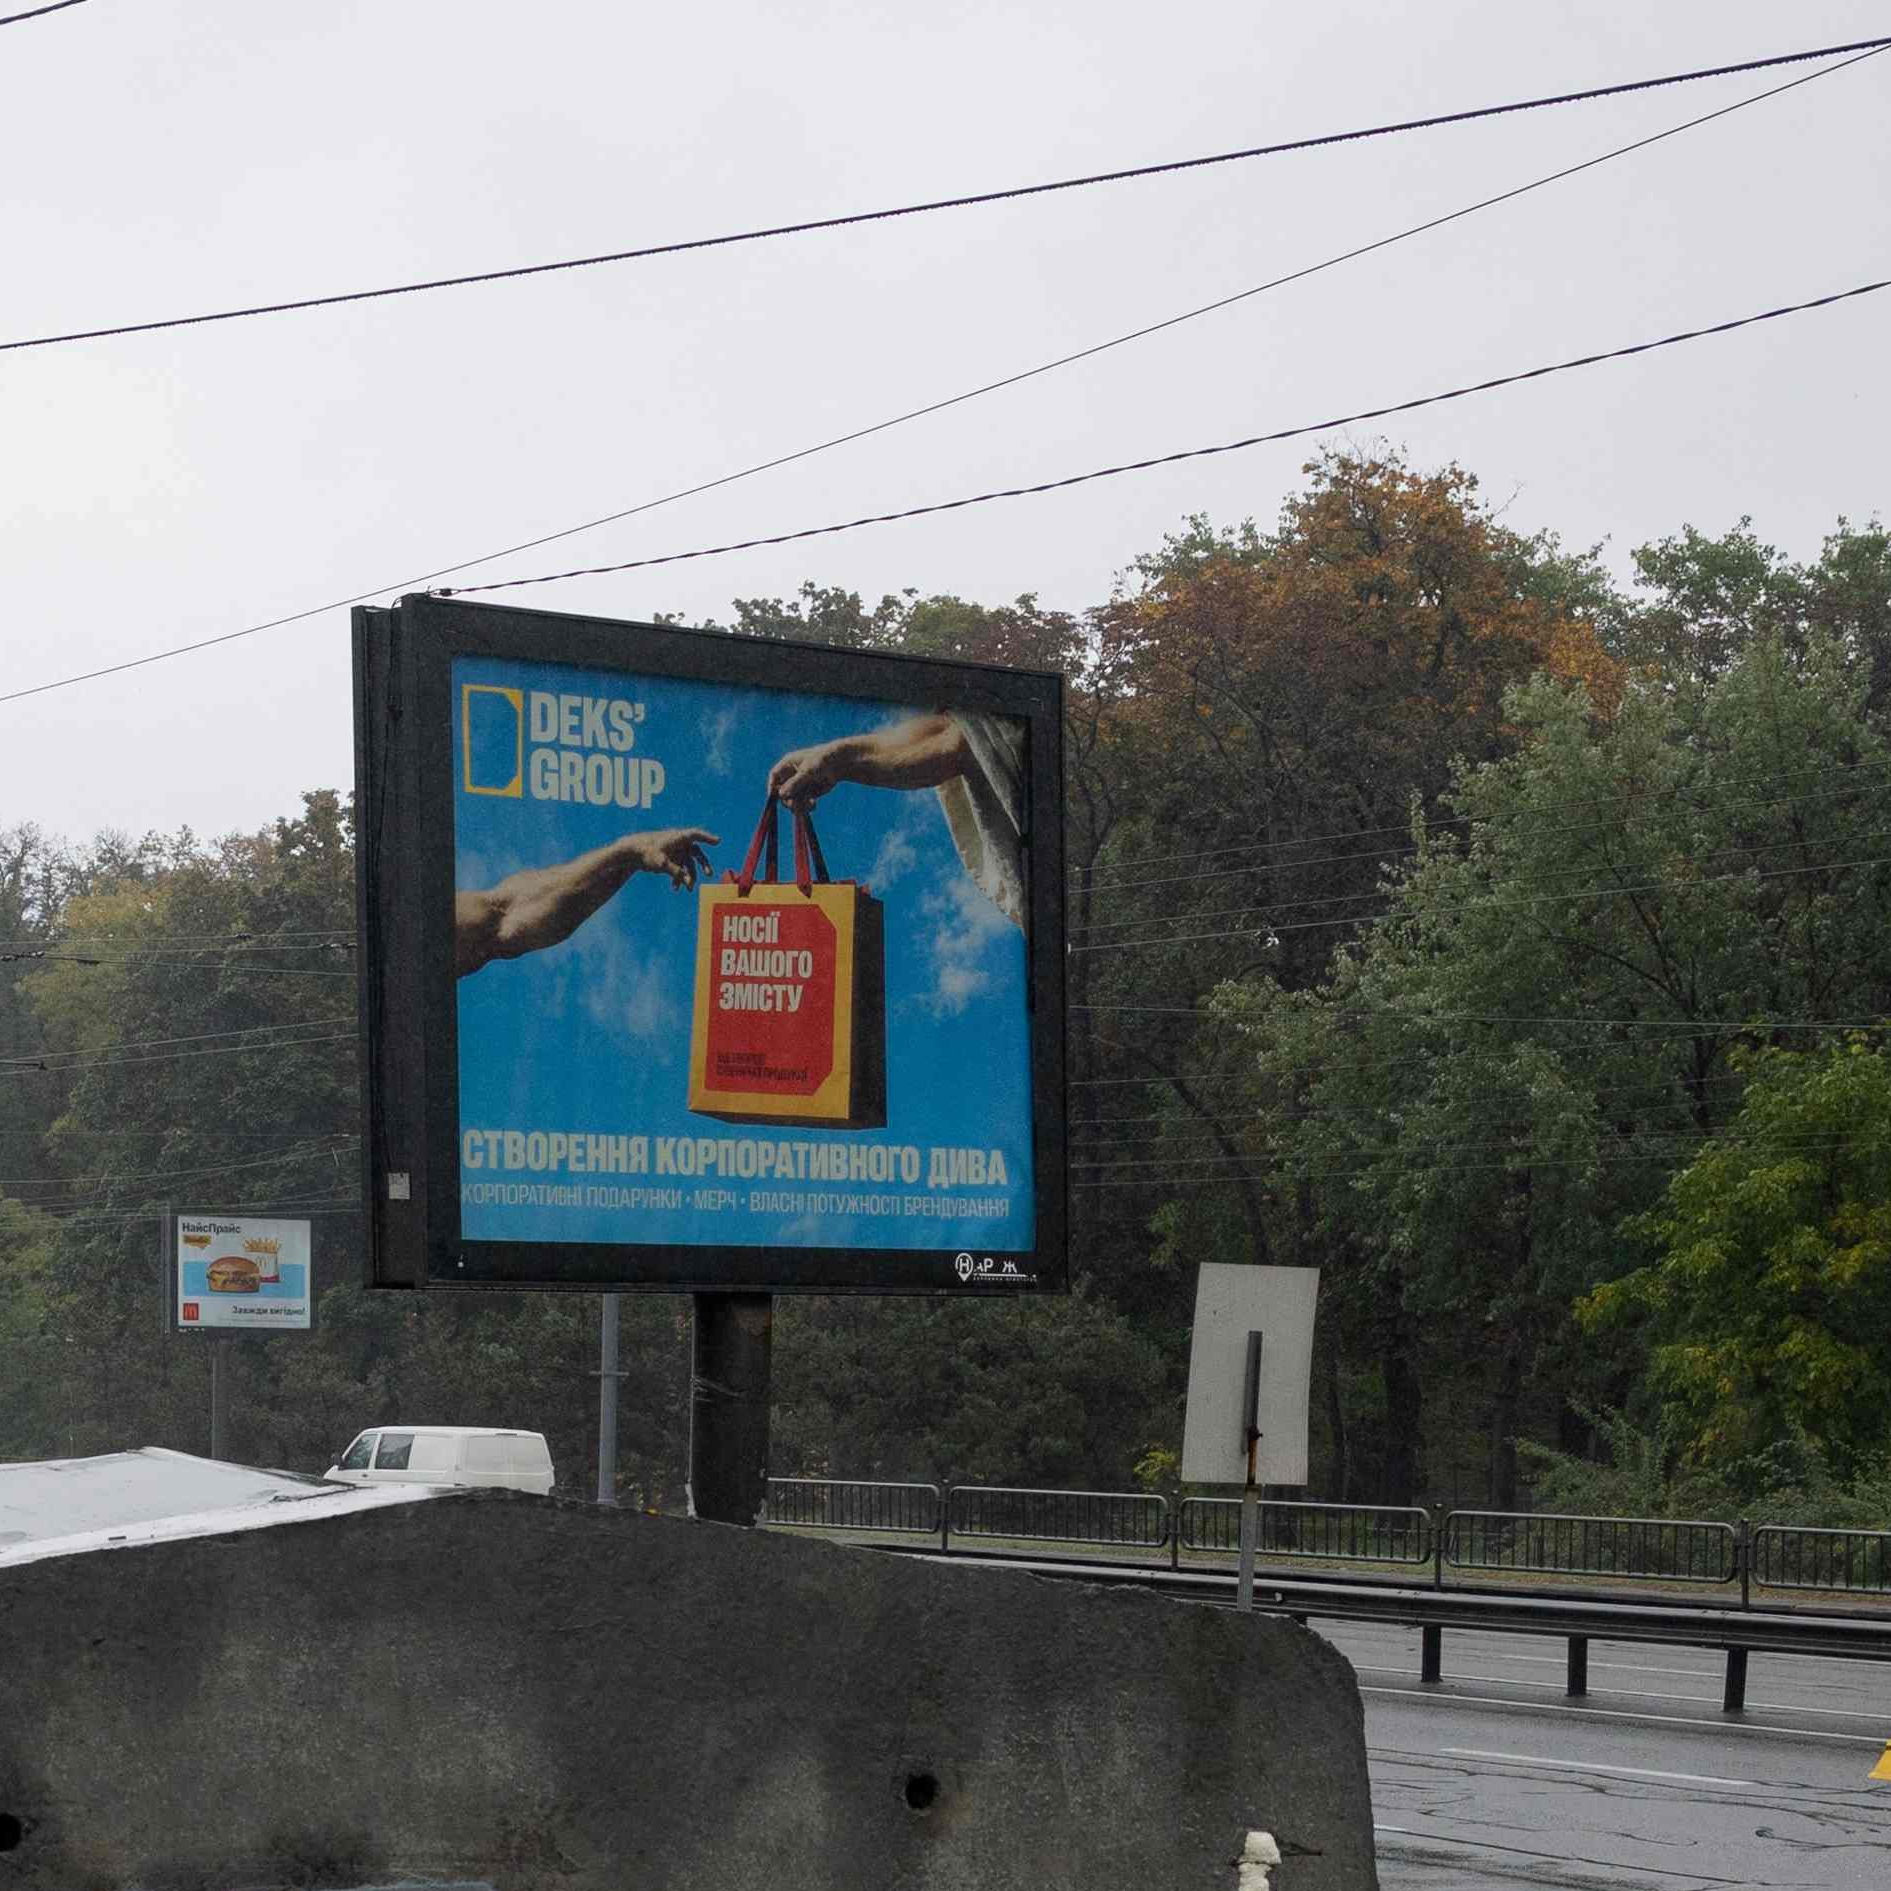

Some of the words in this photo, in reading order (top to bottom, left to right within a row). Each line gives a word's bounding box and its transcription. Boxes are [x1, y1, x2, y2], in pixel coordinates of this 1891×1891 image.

[529, 748, 665, 809] GROUP
[722, 911, 781, 944] НОСІЇ
[720, 948, 813, 978] ВАШОГО
[719, 982, 803, 1012] ЗМІСТУ
[462, 1129, 649, 1175] СТВОРЕННЯ
[655, 1136, 921, 1184] КОРПОРАТИВНОГО
[927, 1147, 1008, 1189] ДИВА
[460, 1183, 583, 1207] КОРПОРАТИВНІ
[586, 1186, 683, 1210] ПОДАРУНКИ
[693, 1189, 737, 1211] МЕРЧ
[749, 1191, 804, 1214] ВЛАСНІ
[806, 1193, 900, 1217] ПОТУЖНОСТІ
[904, 1197, 1010, 1219] БРЕНДУВАННЯ
